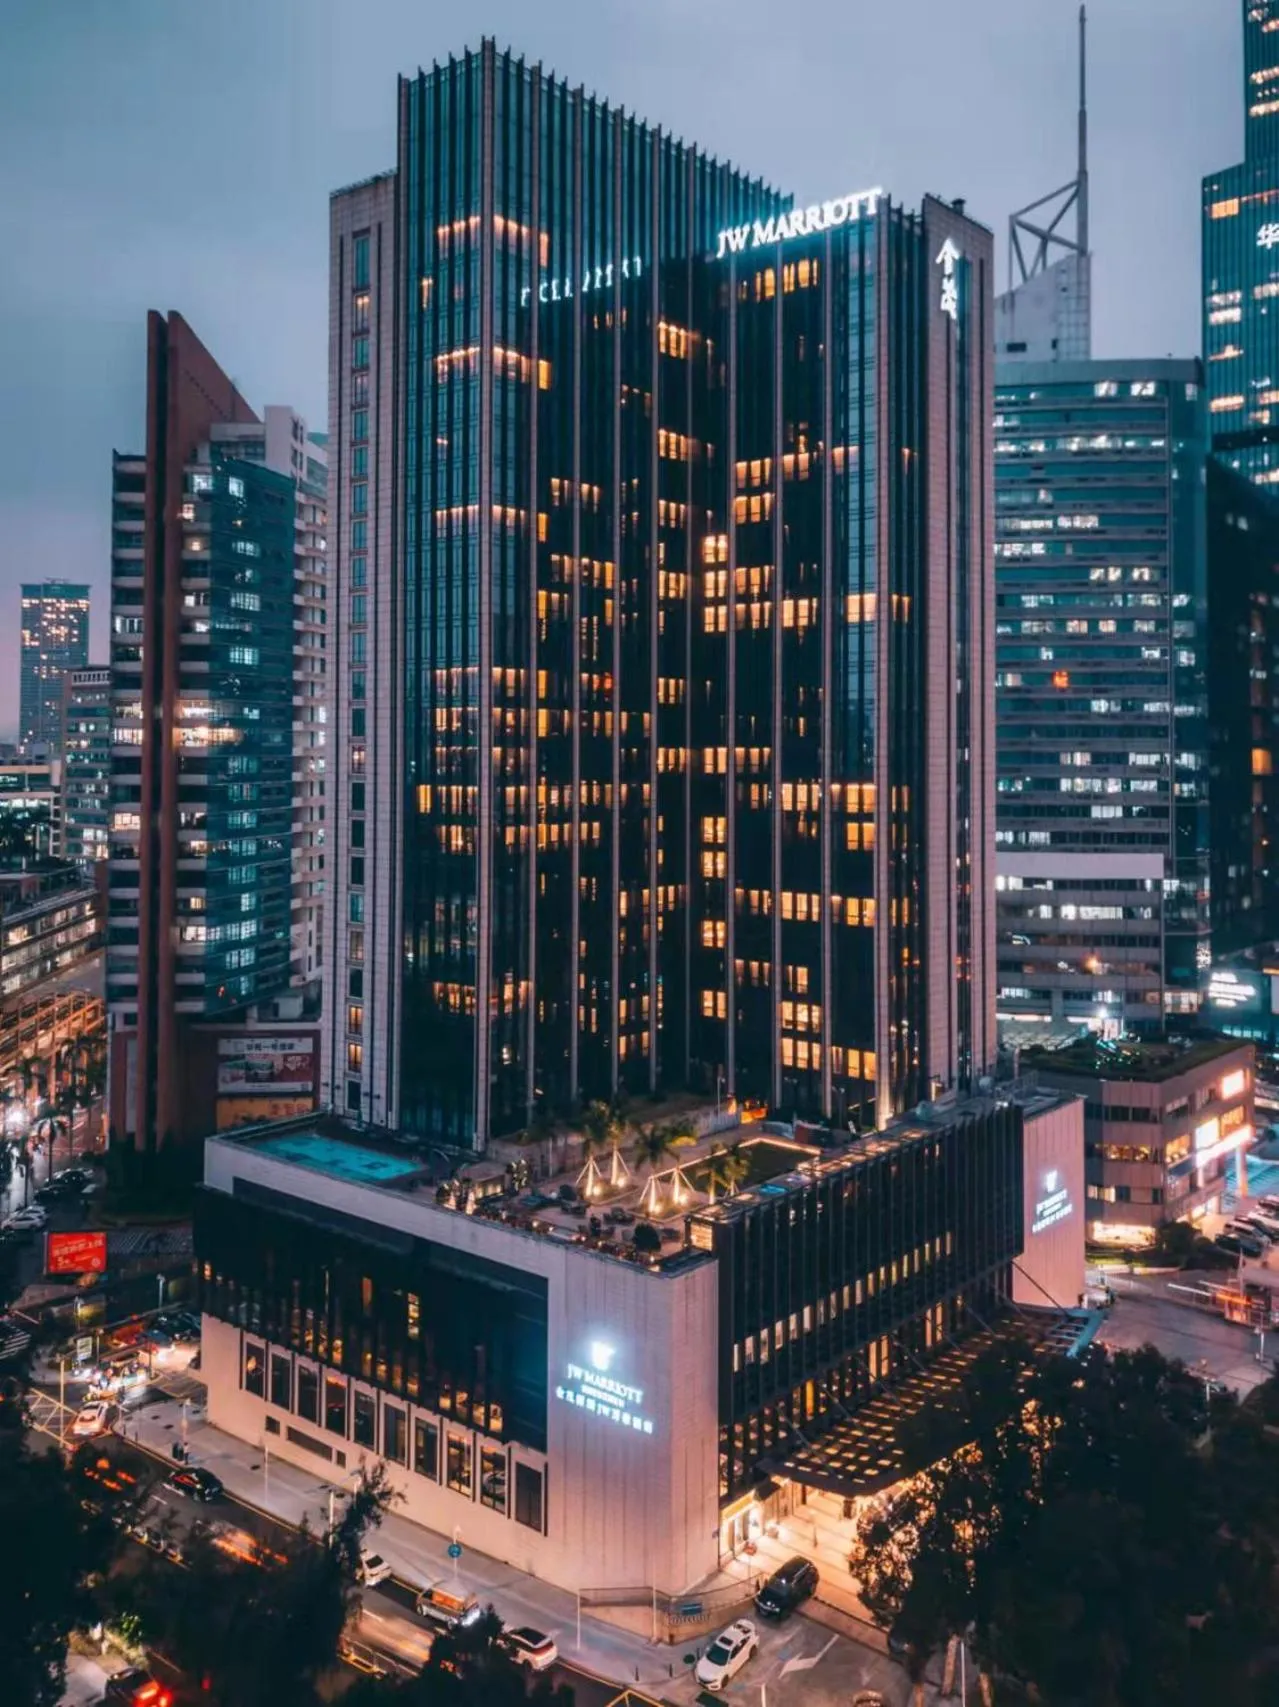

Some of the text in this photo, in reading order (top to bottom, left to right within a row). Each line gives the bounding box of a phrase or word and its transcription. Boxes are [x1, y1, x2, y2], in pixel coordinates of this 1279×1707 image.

[717, 186, 882, 258] JW MARRIOTT
[567, 1363, 583, 1380] JW
[584, 1370, 643, 1404] MARRIOTT
